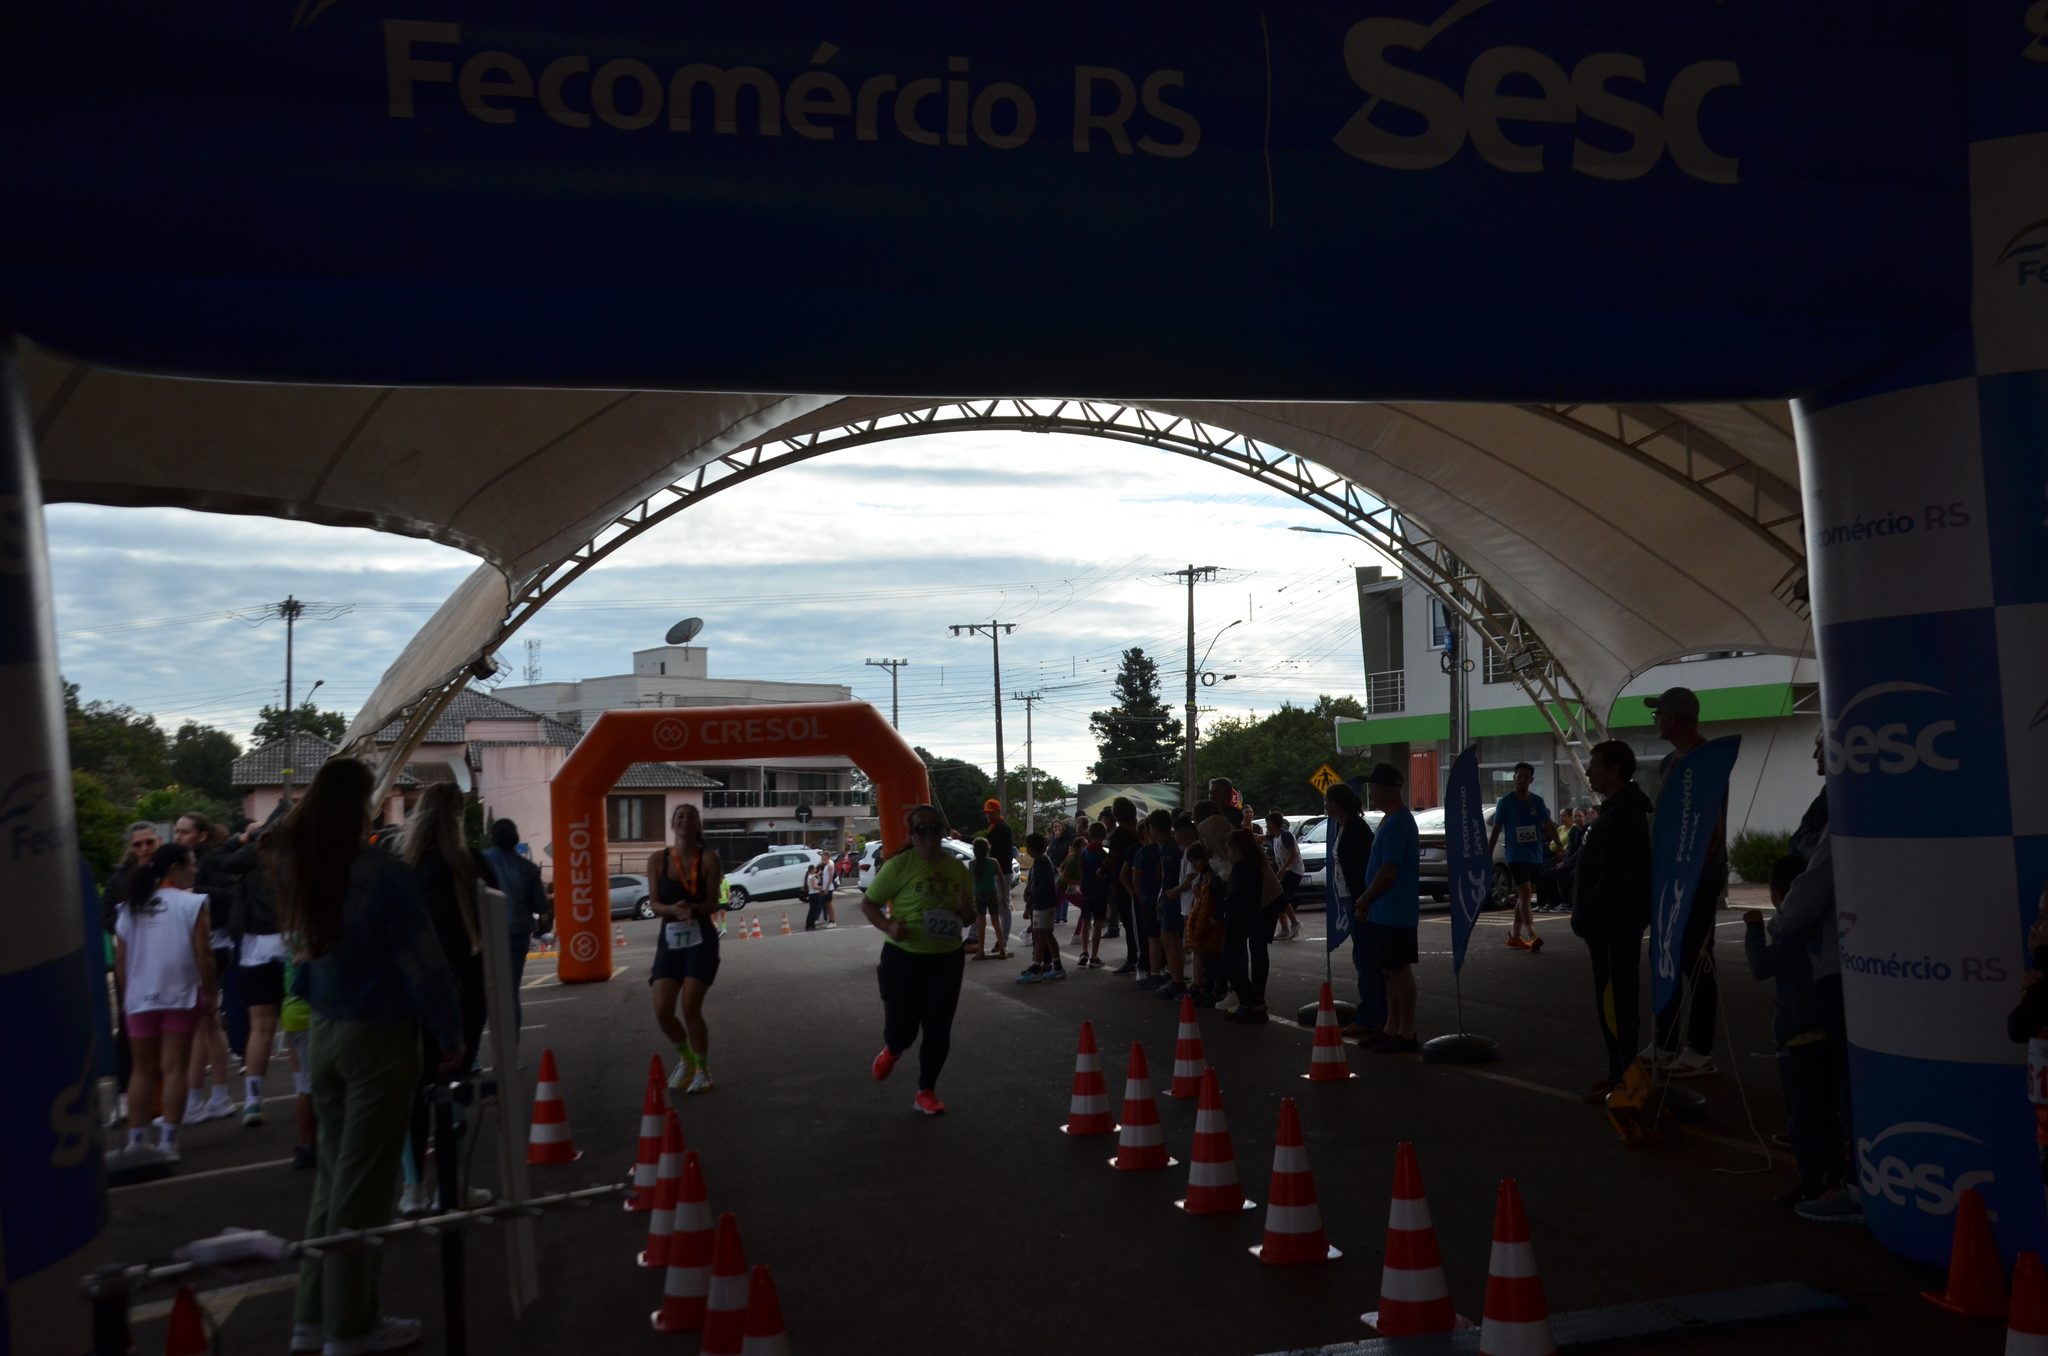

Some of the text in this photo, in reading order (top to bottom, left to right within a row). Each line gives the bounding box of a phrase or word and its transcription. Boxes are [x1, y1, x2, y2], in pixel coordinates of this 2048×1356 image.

[384, 18, 1200, 159] Fecomércio RS
[1331, 15, 1742, 185] Sesc
[1925, 502, 1970, 530] RS
[700, 716, 830, 744] CRESOL
[1520, 831, 1536, 841] 504
[569, 813, 594, 923] CRESOL
[674, 931, 692, 946] 77
[928, 918, 958, 935] 222
[1962, 956, 2008, 983] RS
